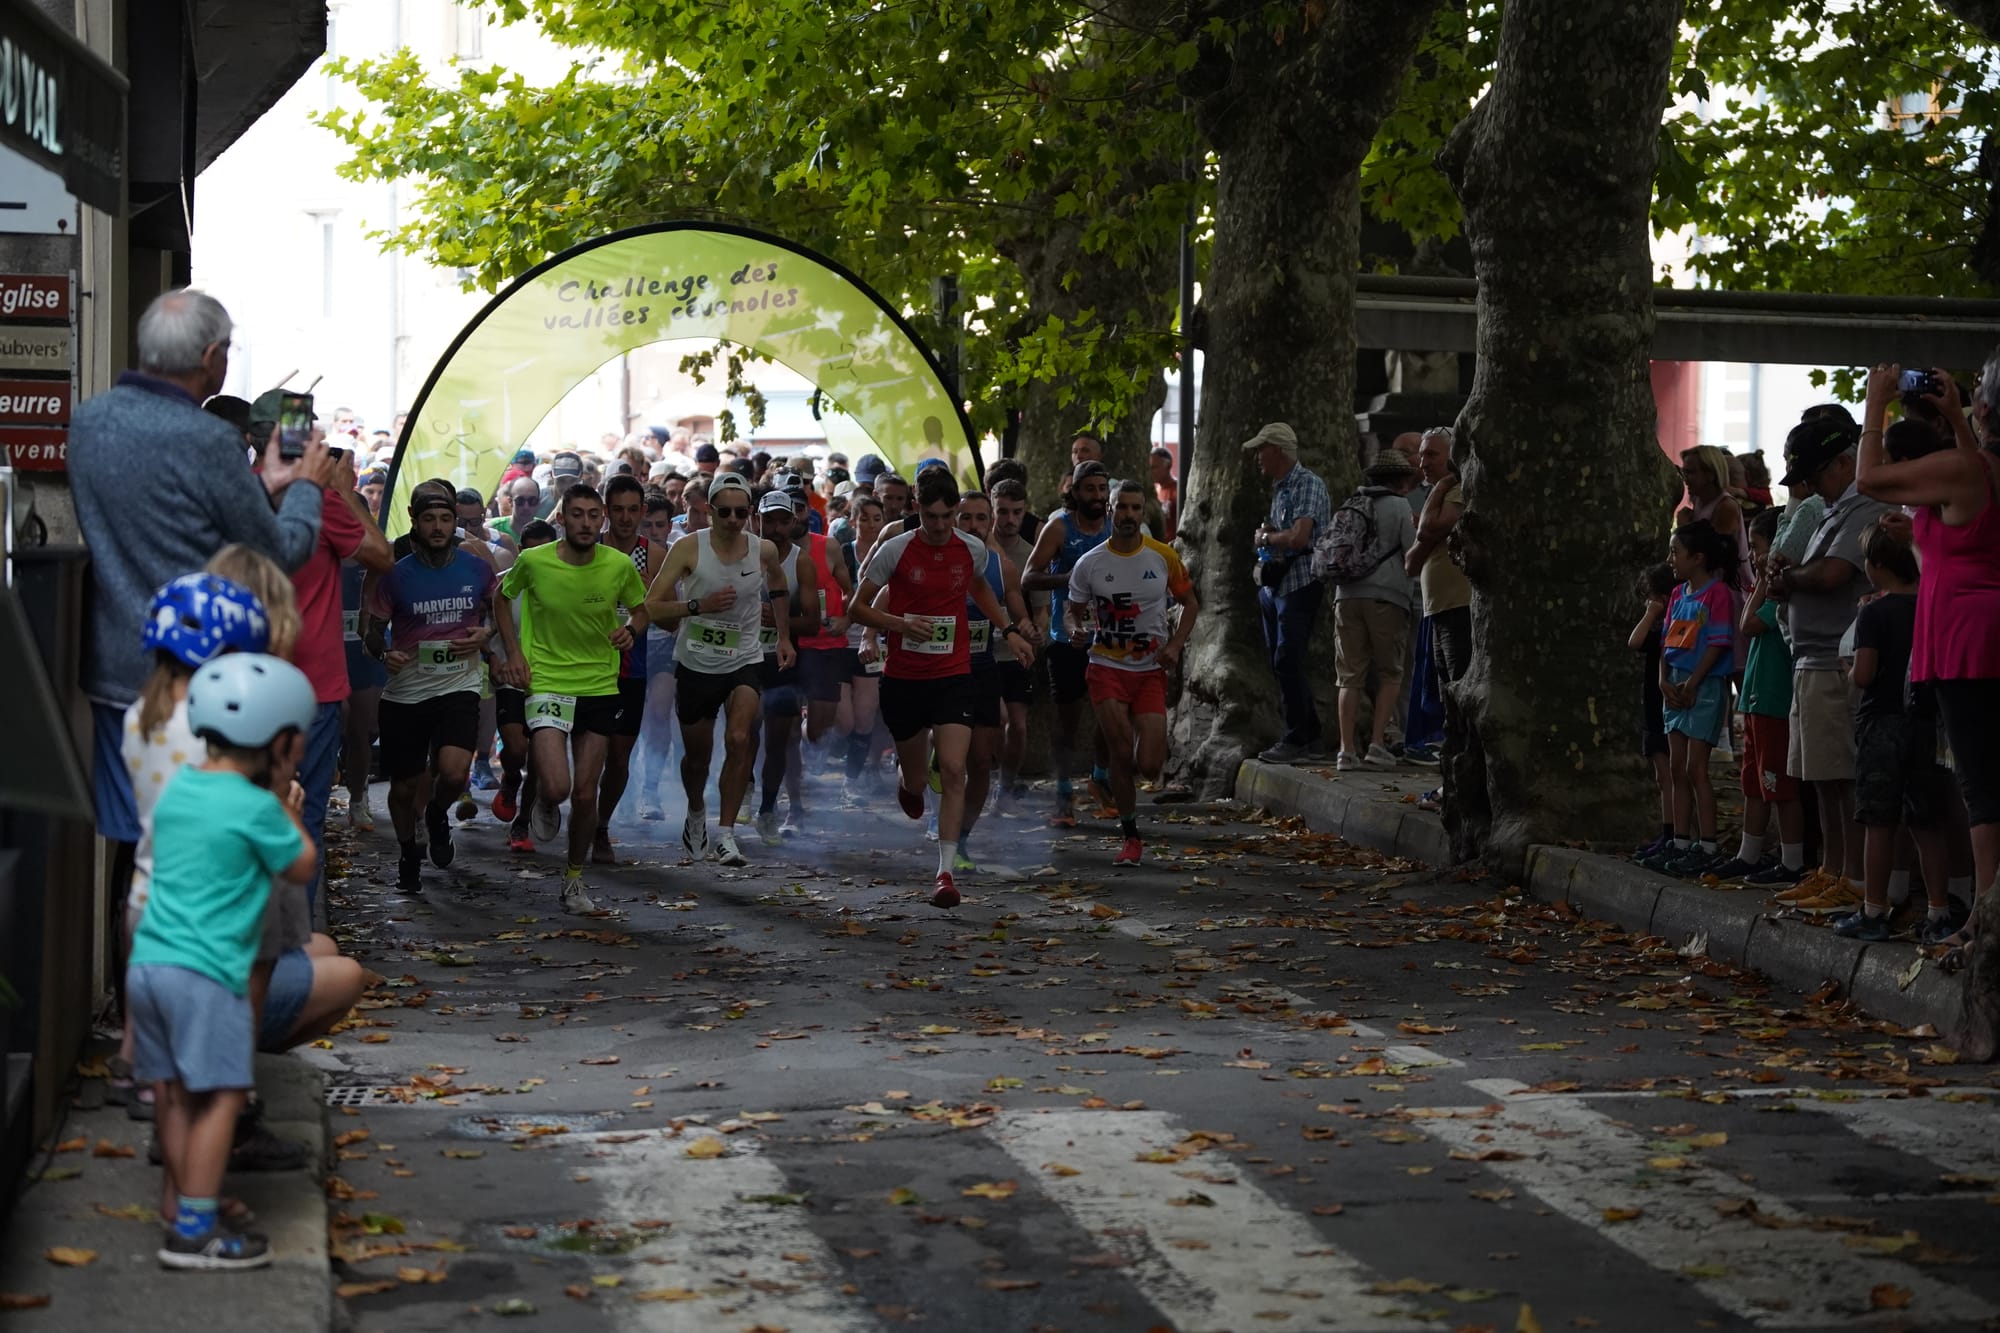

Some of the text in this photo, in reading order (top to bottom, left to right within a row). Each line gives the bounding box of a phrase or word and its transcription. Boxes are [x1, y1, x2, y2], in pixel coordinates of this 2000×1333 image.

[558, 263, 778, 301] Challenge des
[544, 288, 798, 329] vallées cévenoles
[412, 597, 474, 615] MARVEJOLS
[425, 611, 463, 625] MENDE
[702, 628, 727, 646] 53
[433, 650, 457, 664] 60
[537, 702, 562, 717] 43
